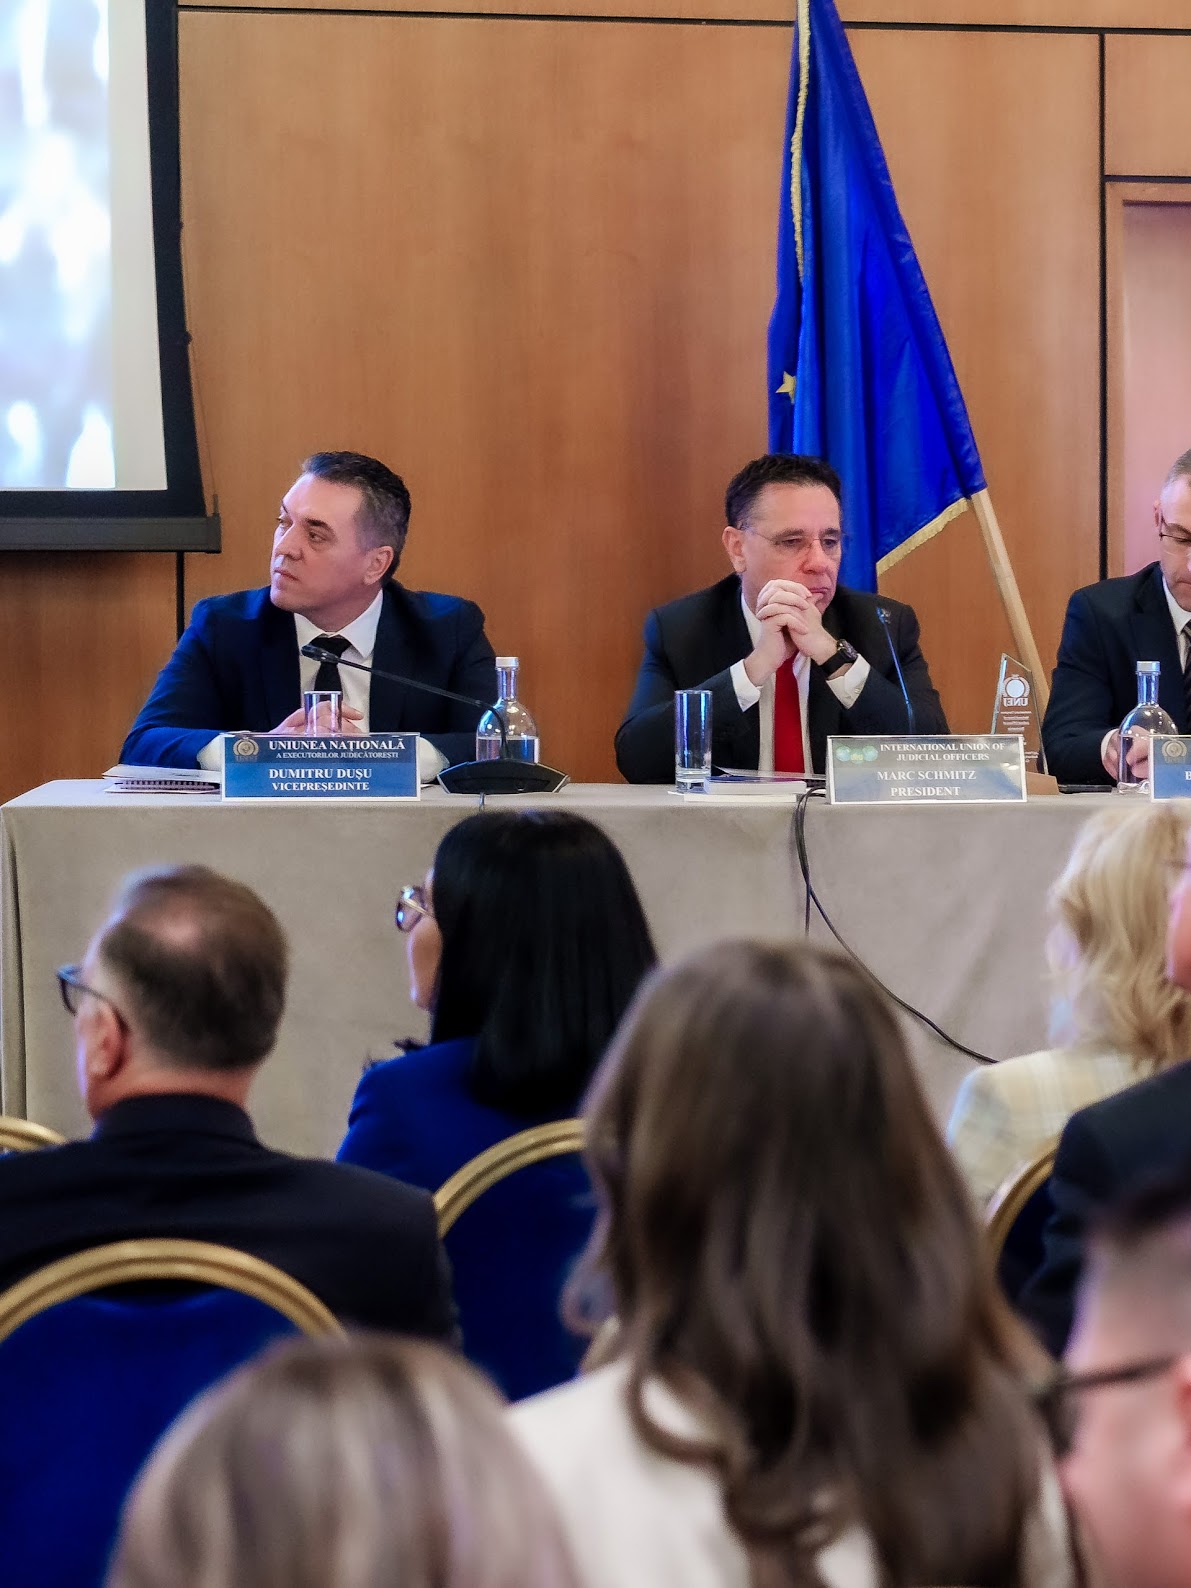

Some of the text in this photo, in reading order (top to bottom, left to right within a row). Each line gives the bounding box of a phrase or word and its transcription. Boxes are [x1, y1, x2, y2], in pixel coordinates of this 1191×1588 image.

[269, 740, 327, 750] UNIUNEA
[880, 742, 1006, 751] INTERNATIONAL UNION OF
[896, 753, 990, 762] JUDICIAL OFFICERS
[269, 769, 333, 779] DUMITRU
[877, 770, 976, 781] MARC SCHMITZ
[891, 786, 961, 797] PRESIDENT
